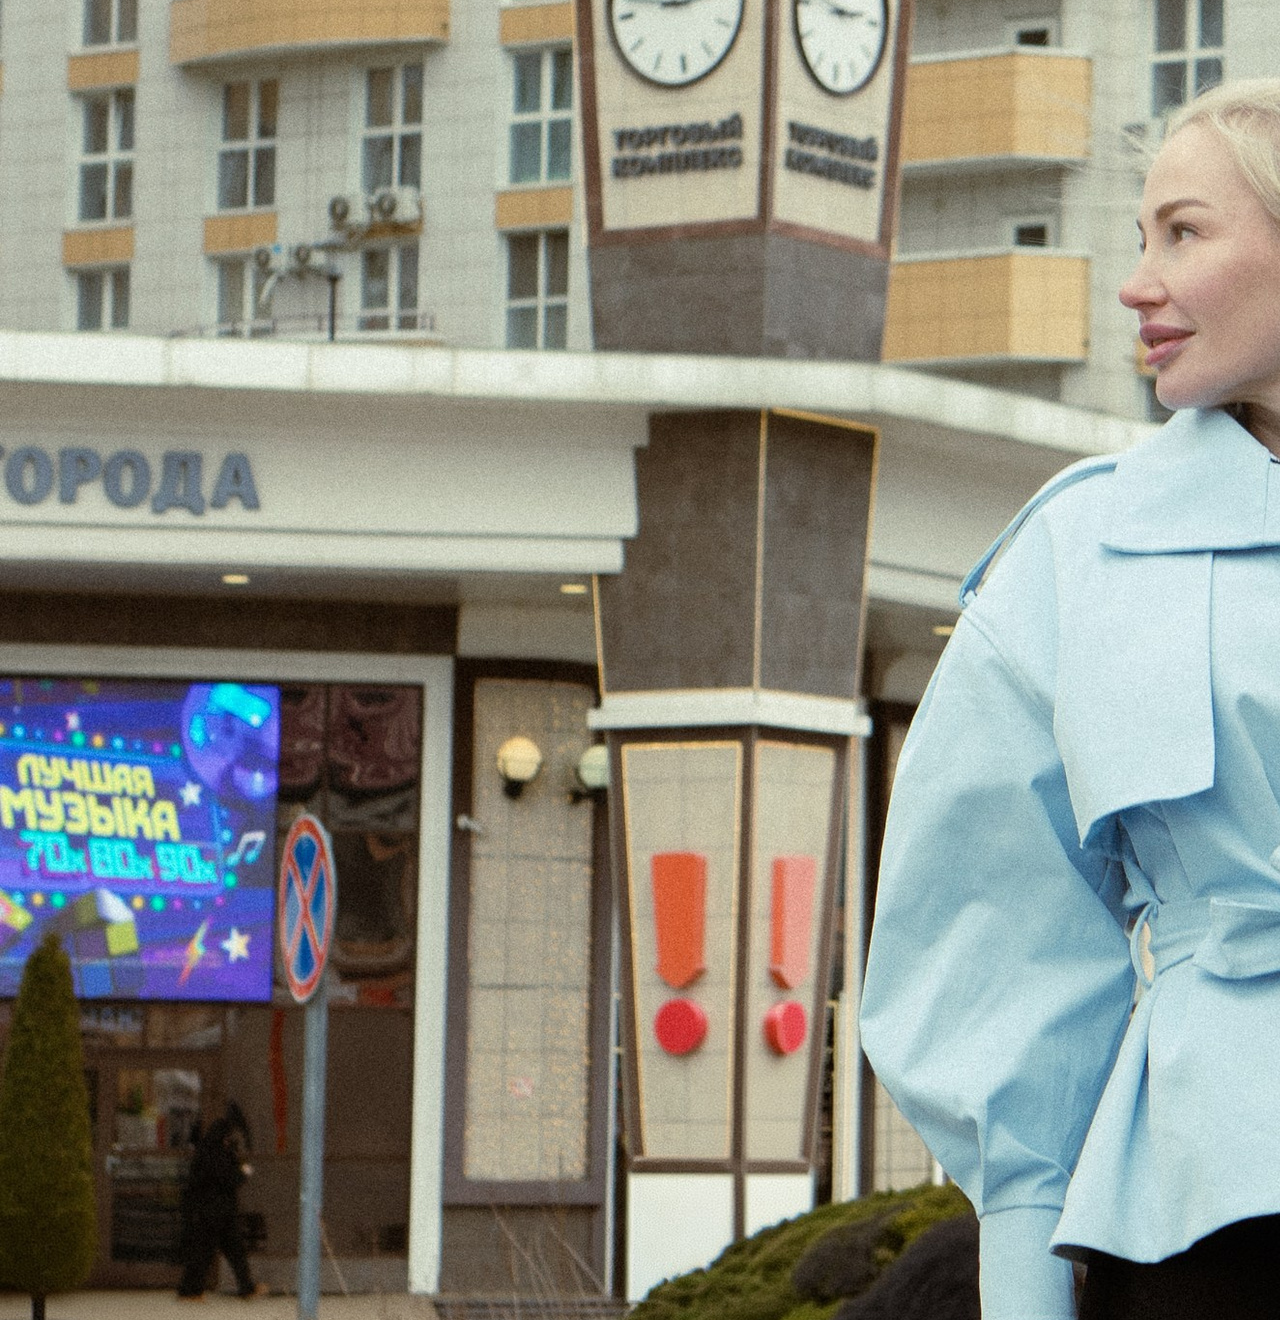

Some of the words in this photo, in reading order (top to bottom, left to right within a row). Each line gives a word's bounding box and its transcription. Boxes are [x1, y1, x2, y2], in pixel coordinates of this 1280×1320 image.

[0, 445, 261, 515] ОРОДА
[17, 753, 155, 798] ЛУЧШАЯ
[0, 785, 182, 842] МУЗЫКА
